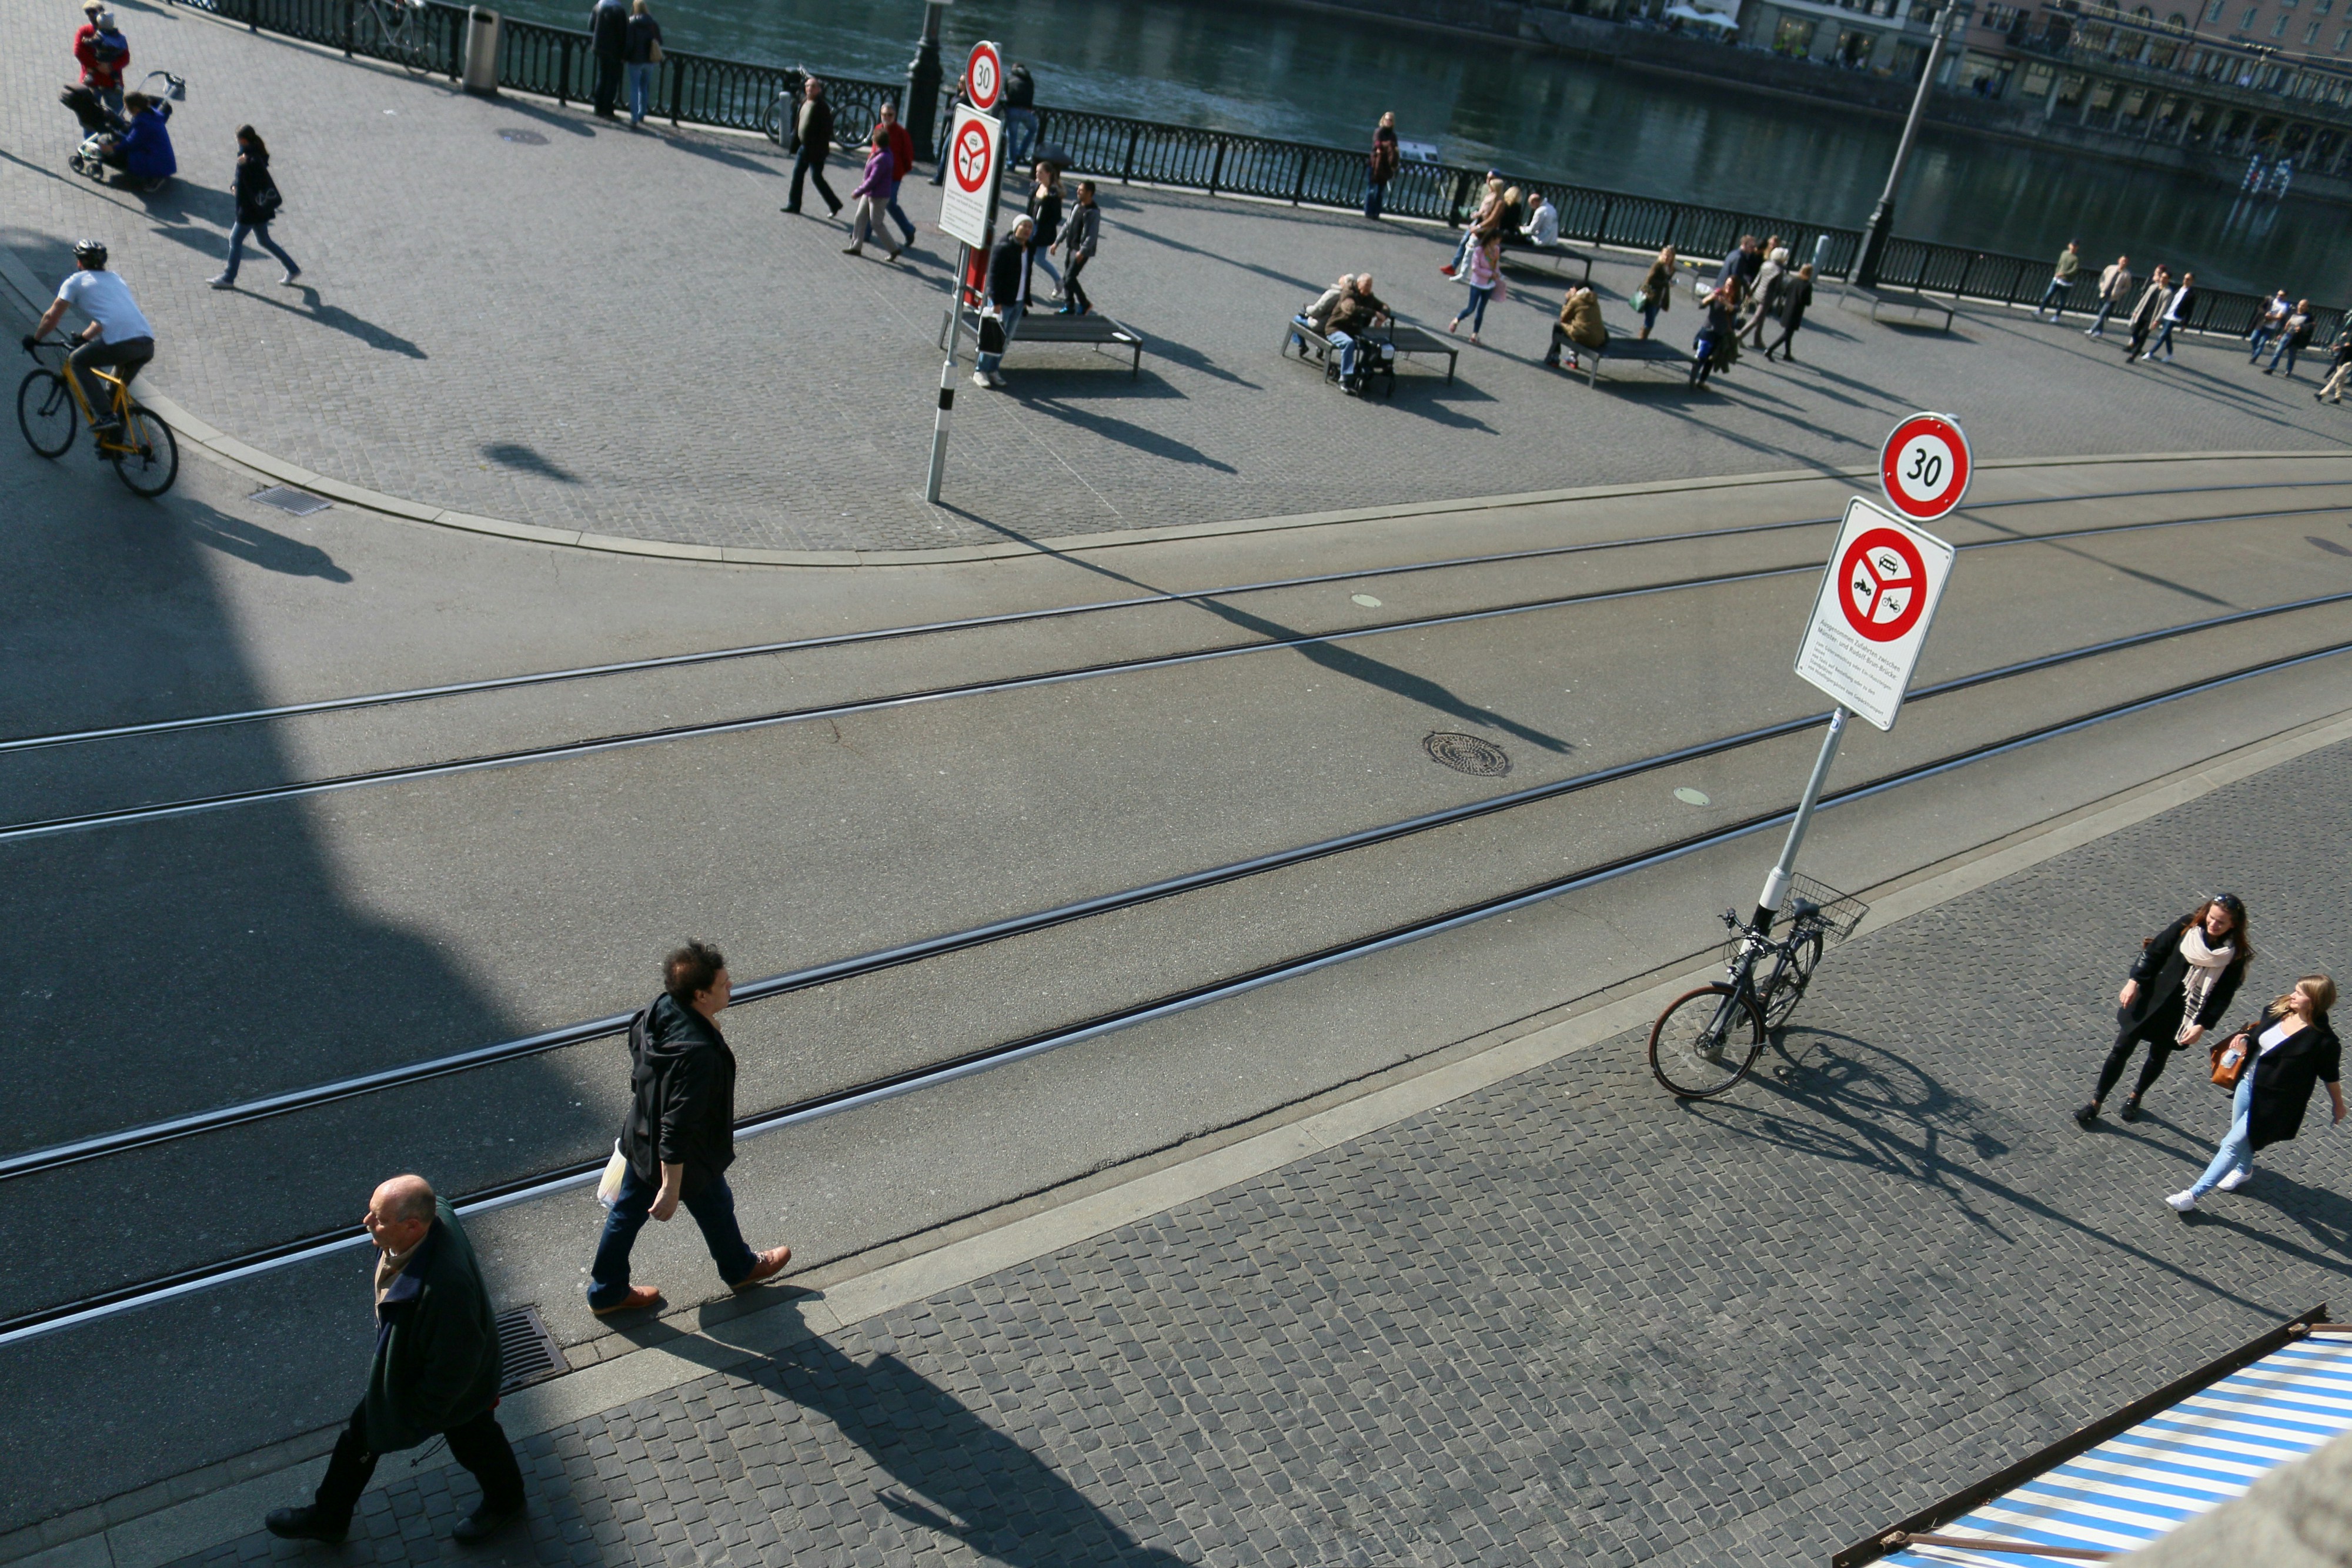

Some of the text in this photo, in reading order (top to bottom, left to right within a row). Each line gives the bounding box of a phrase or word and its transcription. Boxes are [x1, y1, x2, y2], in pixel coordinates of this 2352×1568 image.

[976, 63, 990, 89] 30
[1907, 448, 1942, 487] 30
[1820, 618, 1900, 672] Ausgenommen Zufahrten zwischen
